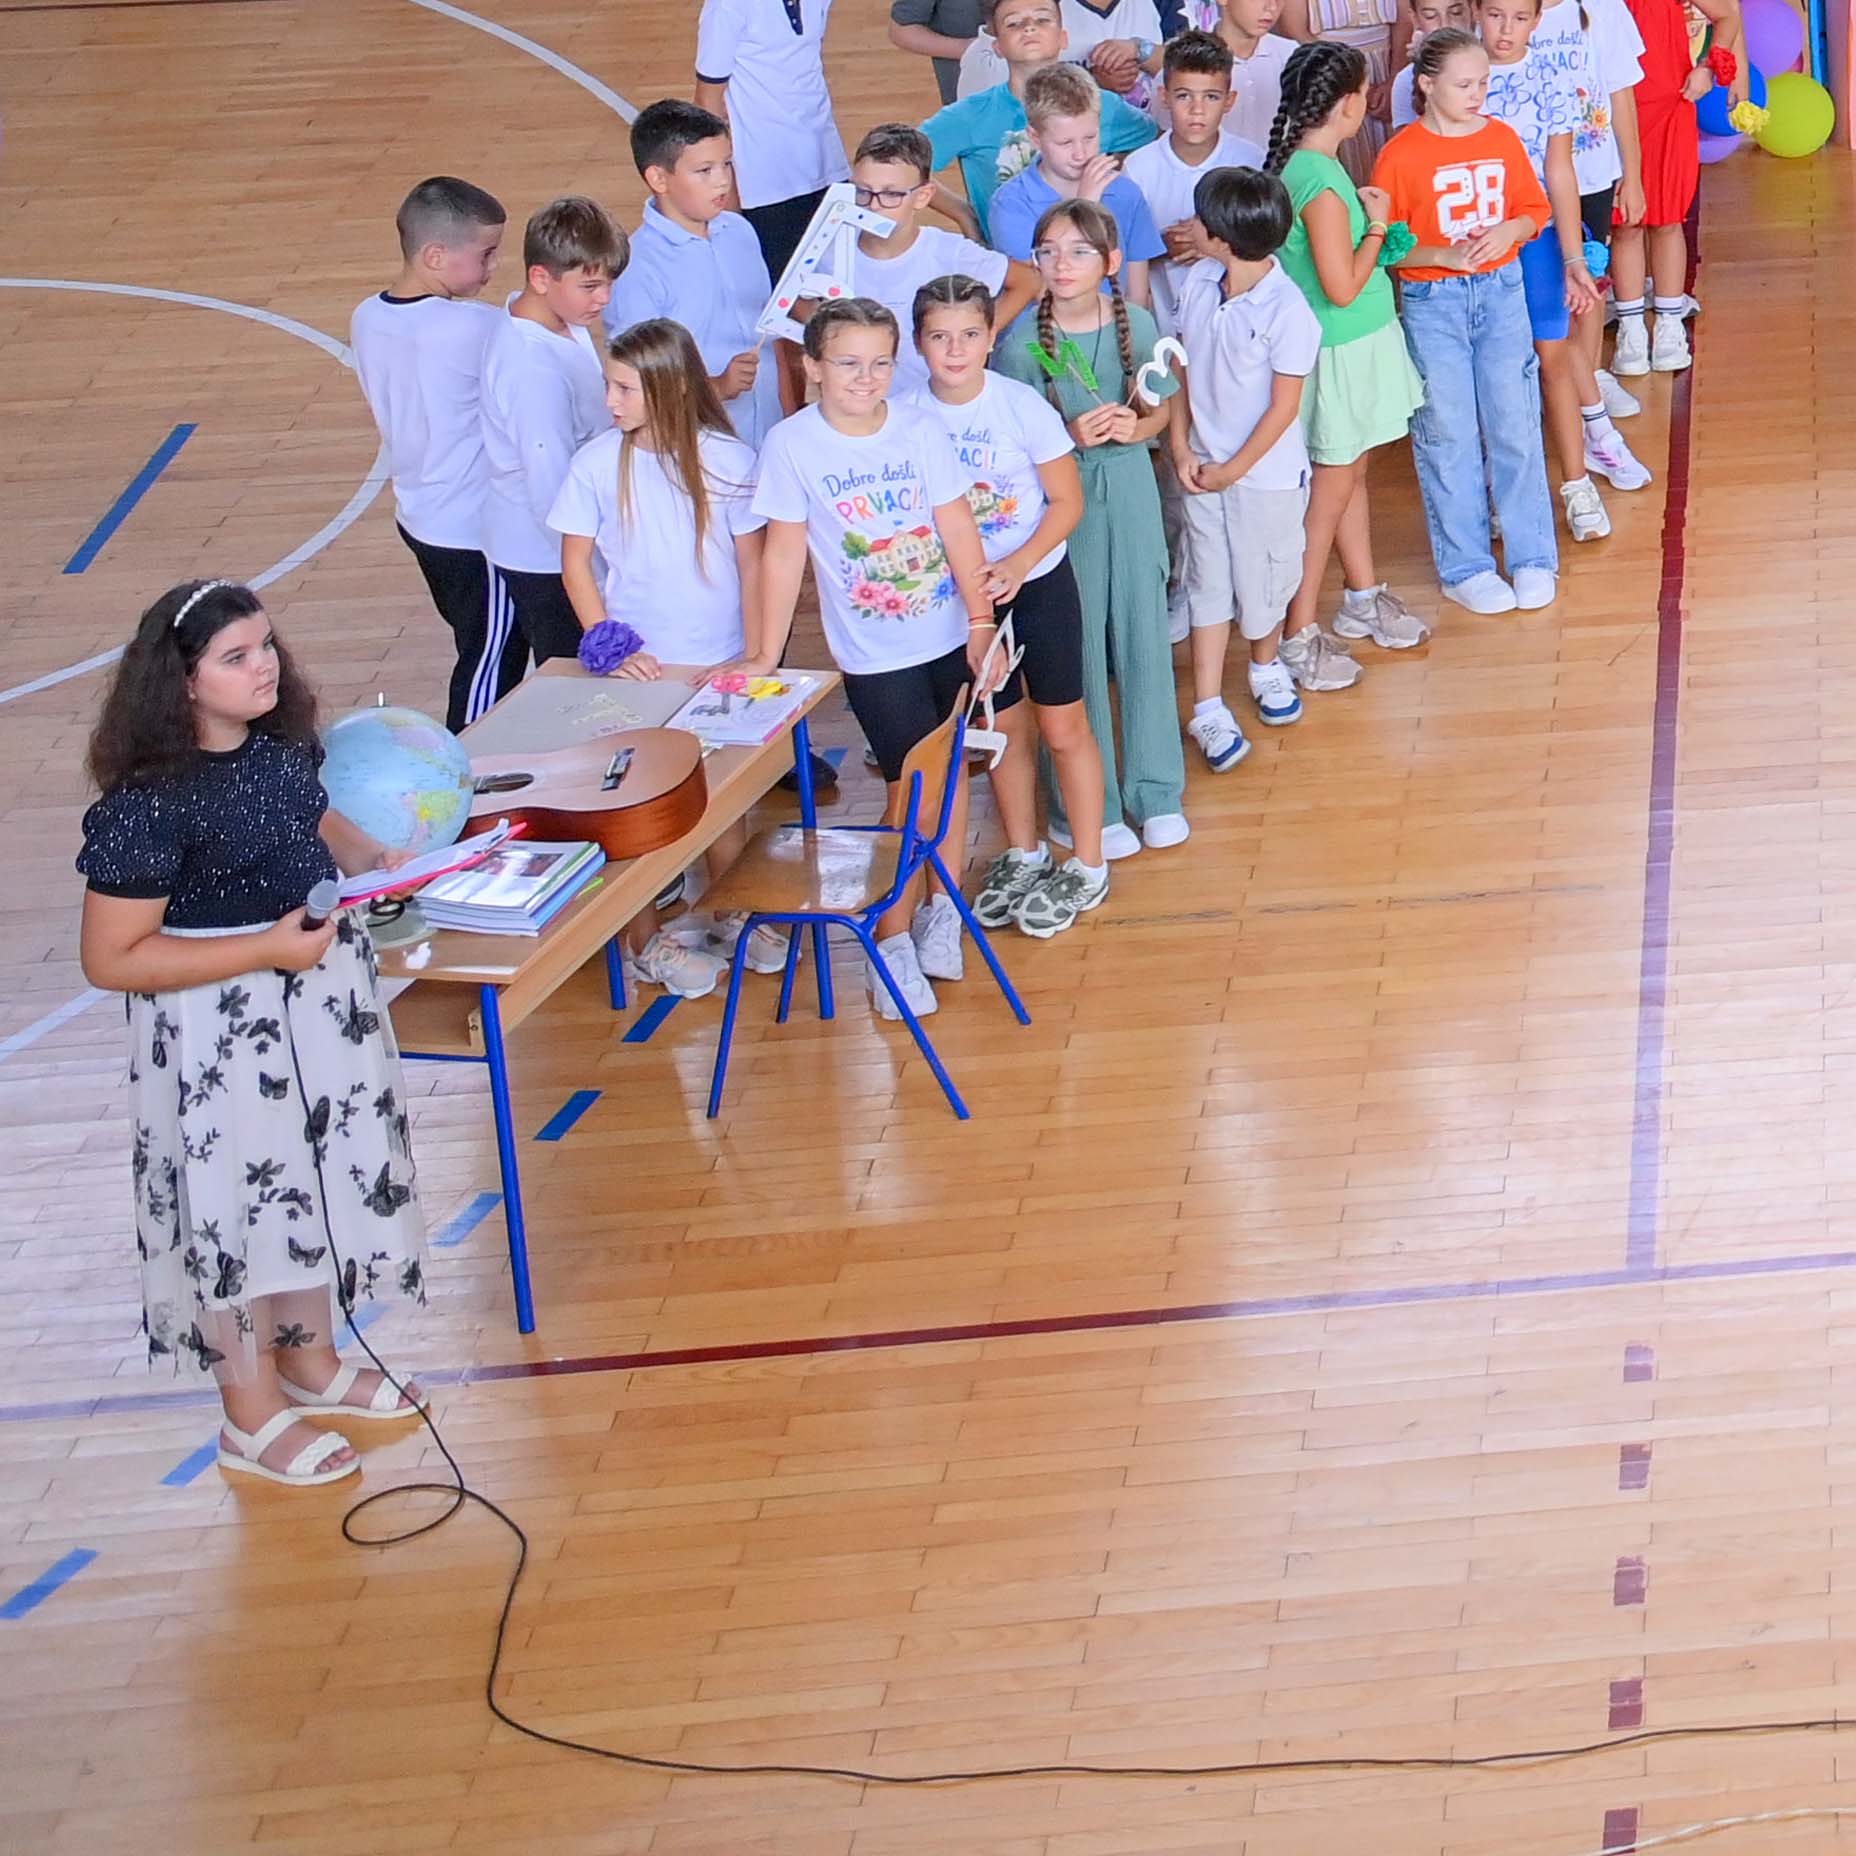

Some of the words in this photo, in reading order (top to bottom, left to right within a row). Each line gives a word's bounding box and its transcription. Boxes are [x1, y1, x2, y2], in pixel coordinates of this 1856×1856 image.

[1432, 163, 1505, 236] 28
[822, 467, 876, 498] Dobro
[880, 459, 917, 482] došli
[835, 486, 924, 525] PRVACI!
